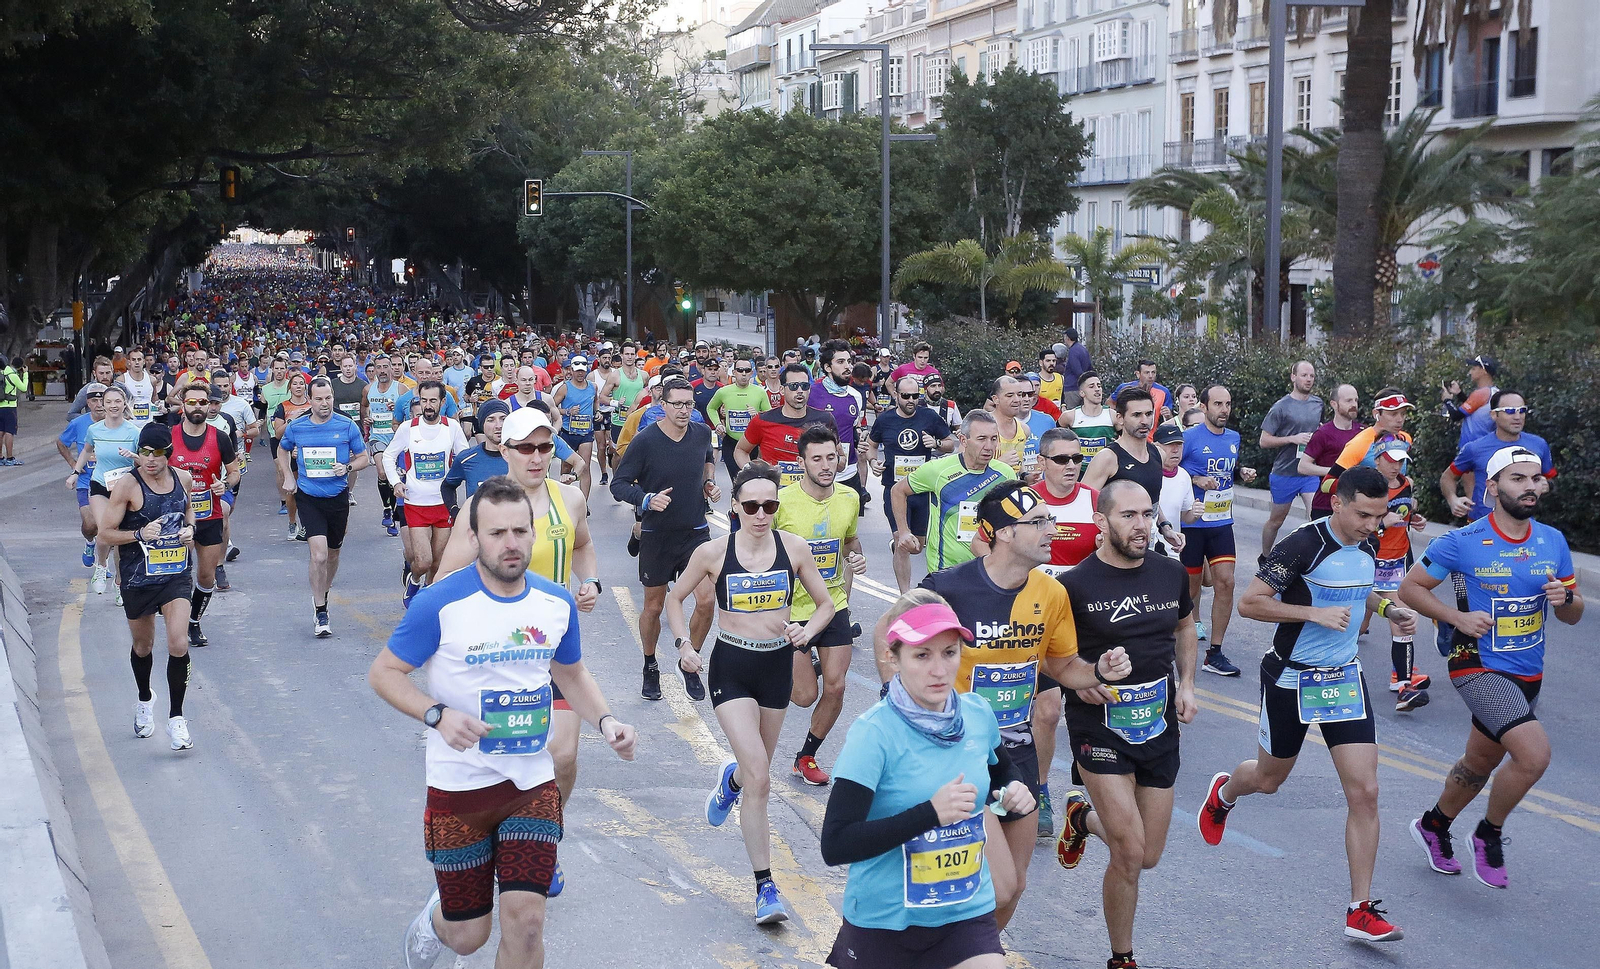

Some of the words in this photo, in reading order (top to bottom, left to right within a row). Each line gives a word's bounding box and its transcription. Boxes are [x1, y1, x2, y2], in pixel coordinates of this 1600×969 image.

[1206, 457, 1236, 472] RCM
[160, 550, 178, 558] 1171
[752, 579, 776, 587] ZURICH
[747, 594, 772, 605] 1187
[1145, 604, 1156, 613] EN
[1513, 616, 1535, 629] 1346
[975, 620, 1045, 638] bichos
[467, 641, 500, 653] sailfish
[975, 636, 1042, 649] runners
[1002, 671, 1027, 680] ZURICH
[1323, 671, 1345, 680] ZURICH
[512, 694, 541, 703] ZURICH
[997, 689, 1017, 702] 561
[1134, 689, 1157, 700] ZURICH
[1321, 687, 1340, 699] 626
[1131, 706, 1151, 720] 556
[507, 713, 533, 728] 844
[939, 825, 972, 839] ZURICH
[935, 849, 969, 869] 1207
